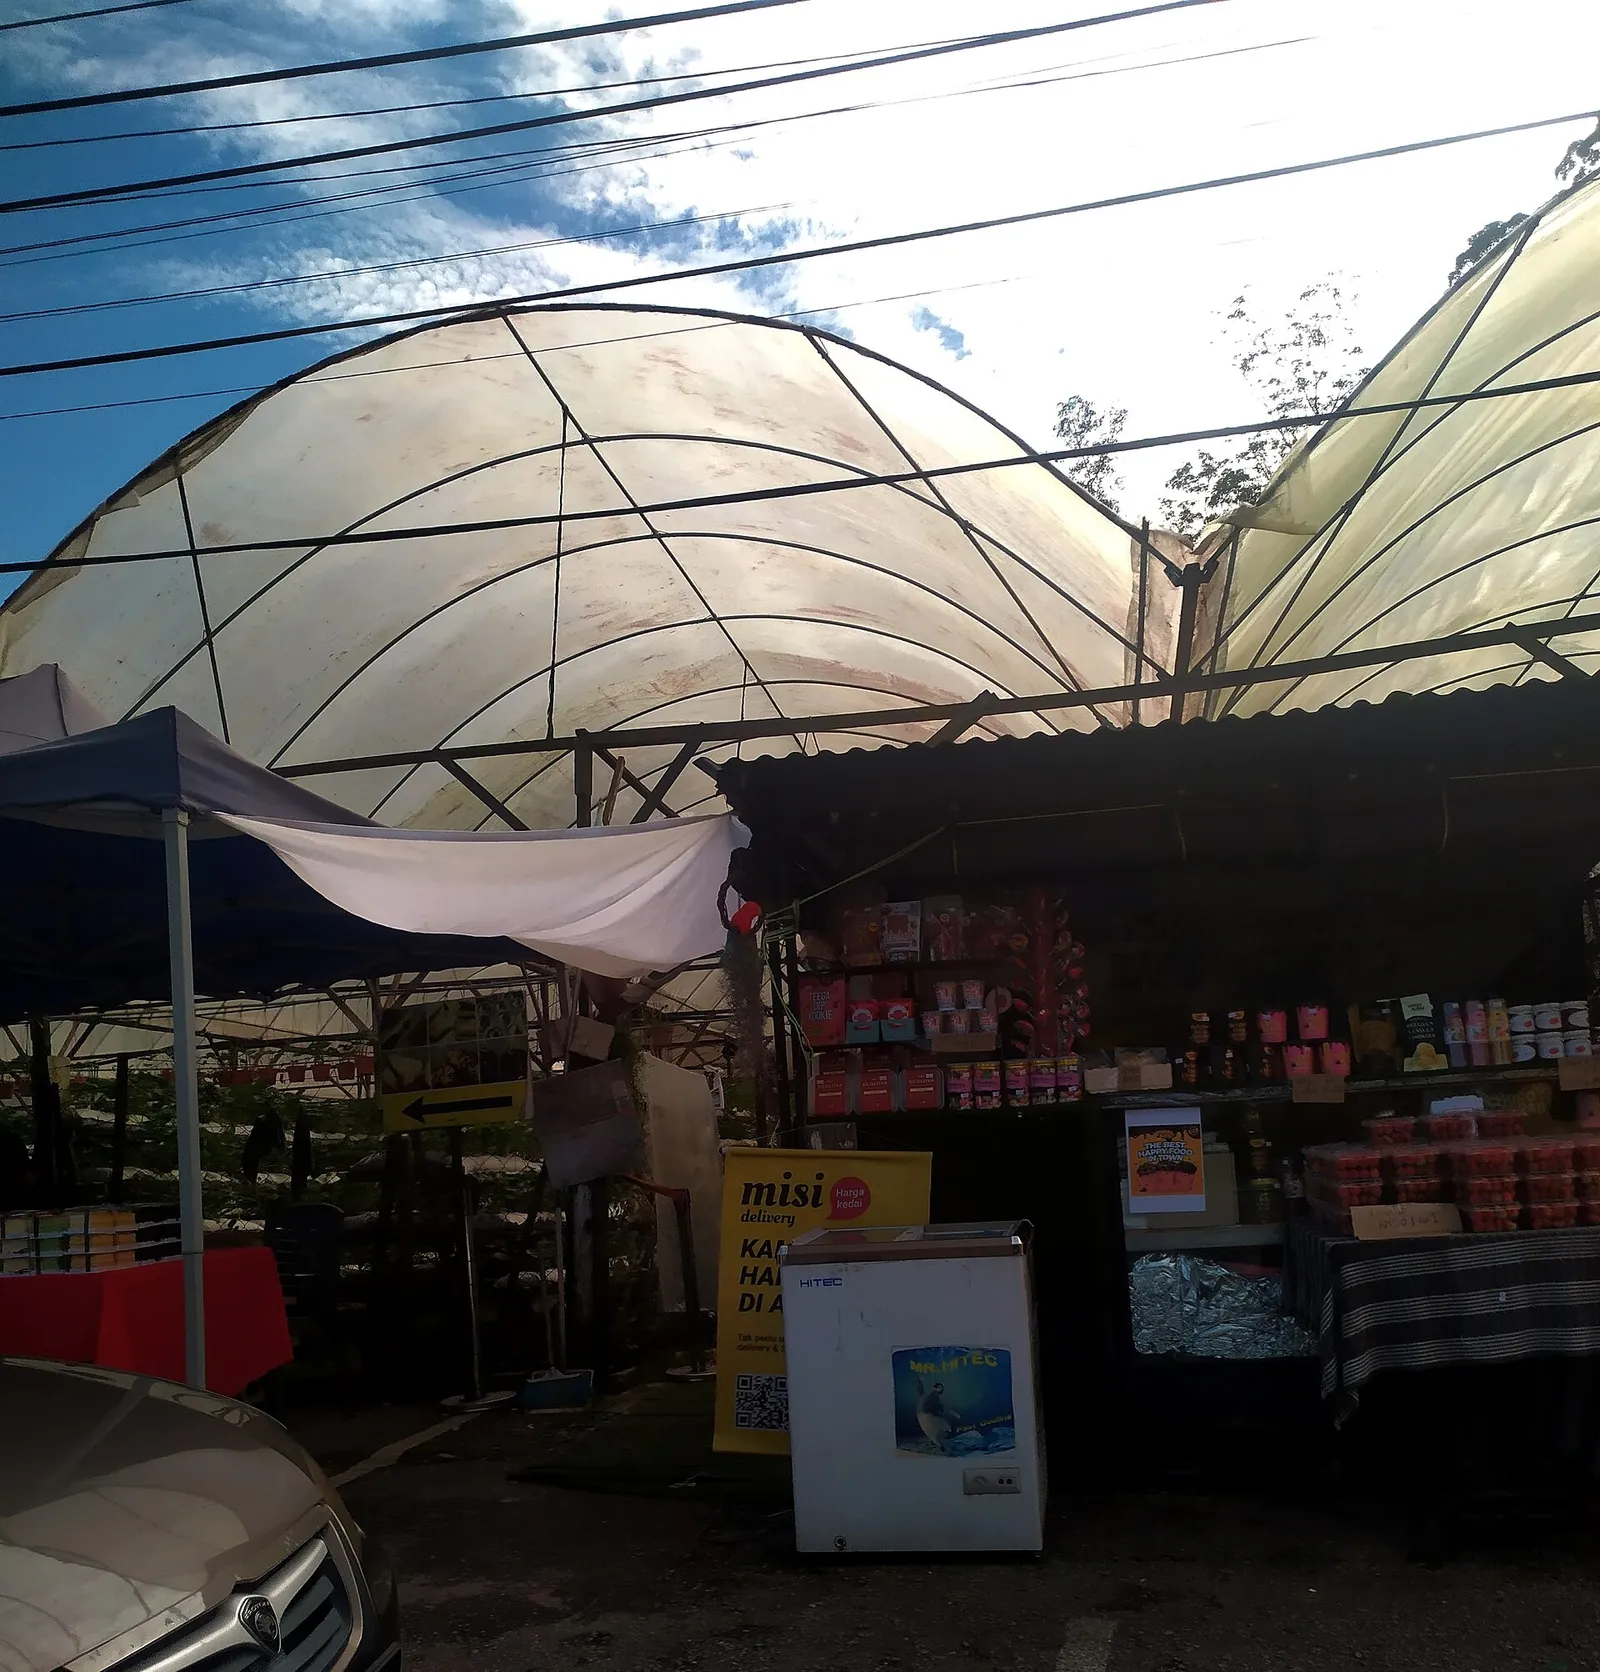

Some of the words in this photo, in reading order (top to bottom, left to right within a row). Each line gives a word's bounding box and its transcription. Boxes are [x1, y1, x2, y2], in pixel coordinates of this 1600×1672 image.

[1159, 1153, 1184, 1161] TOWN
[1169, 1147, 1193, 1156] FOOD
[741, 1171, 824, 1208] misi
[836, 1188, 864, 1199] Harga
[837, 1199, 862, 1209] kedai
[741, 1209, 795, 1228] delivery
[799, 1277, 843, 1288] HITEC
[738, 1293, 763, 1312] DI
